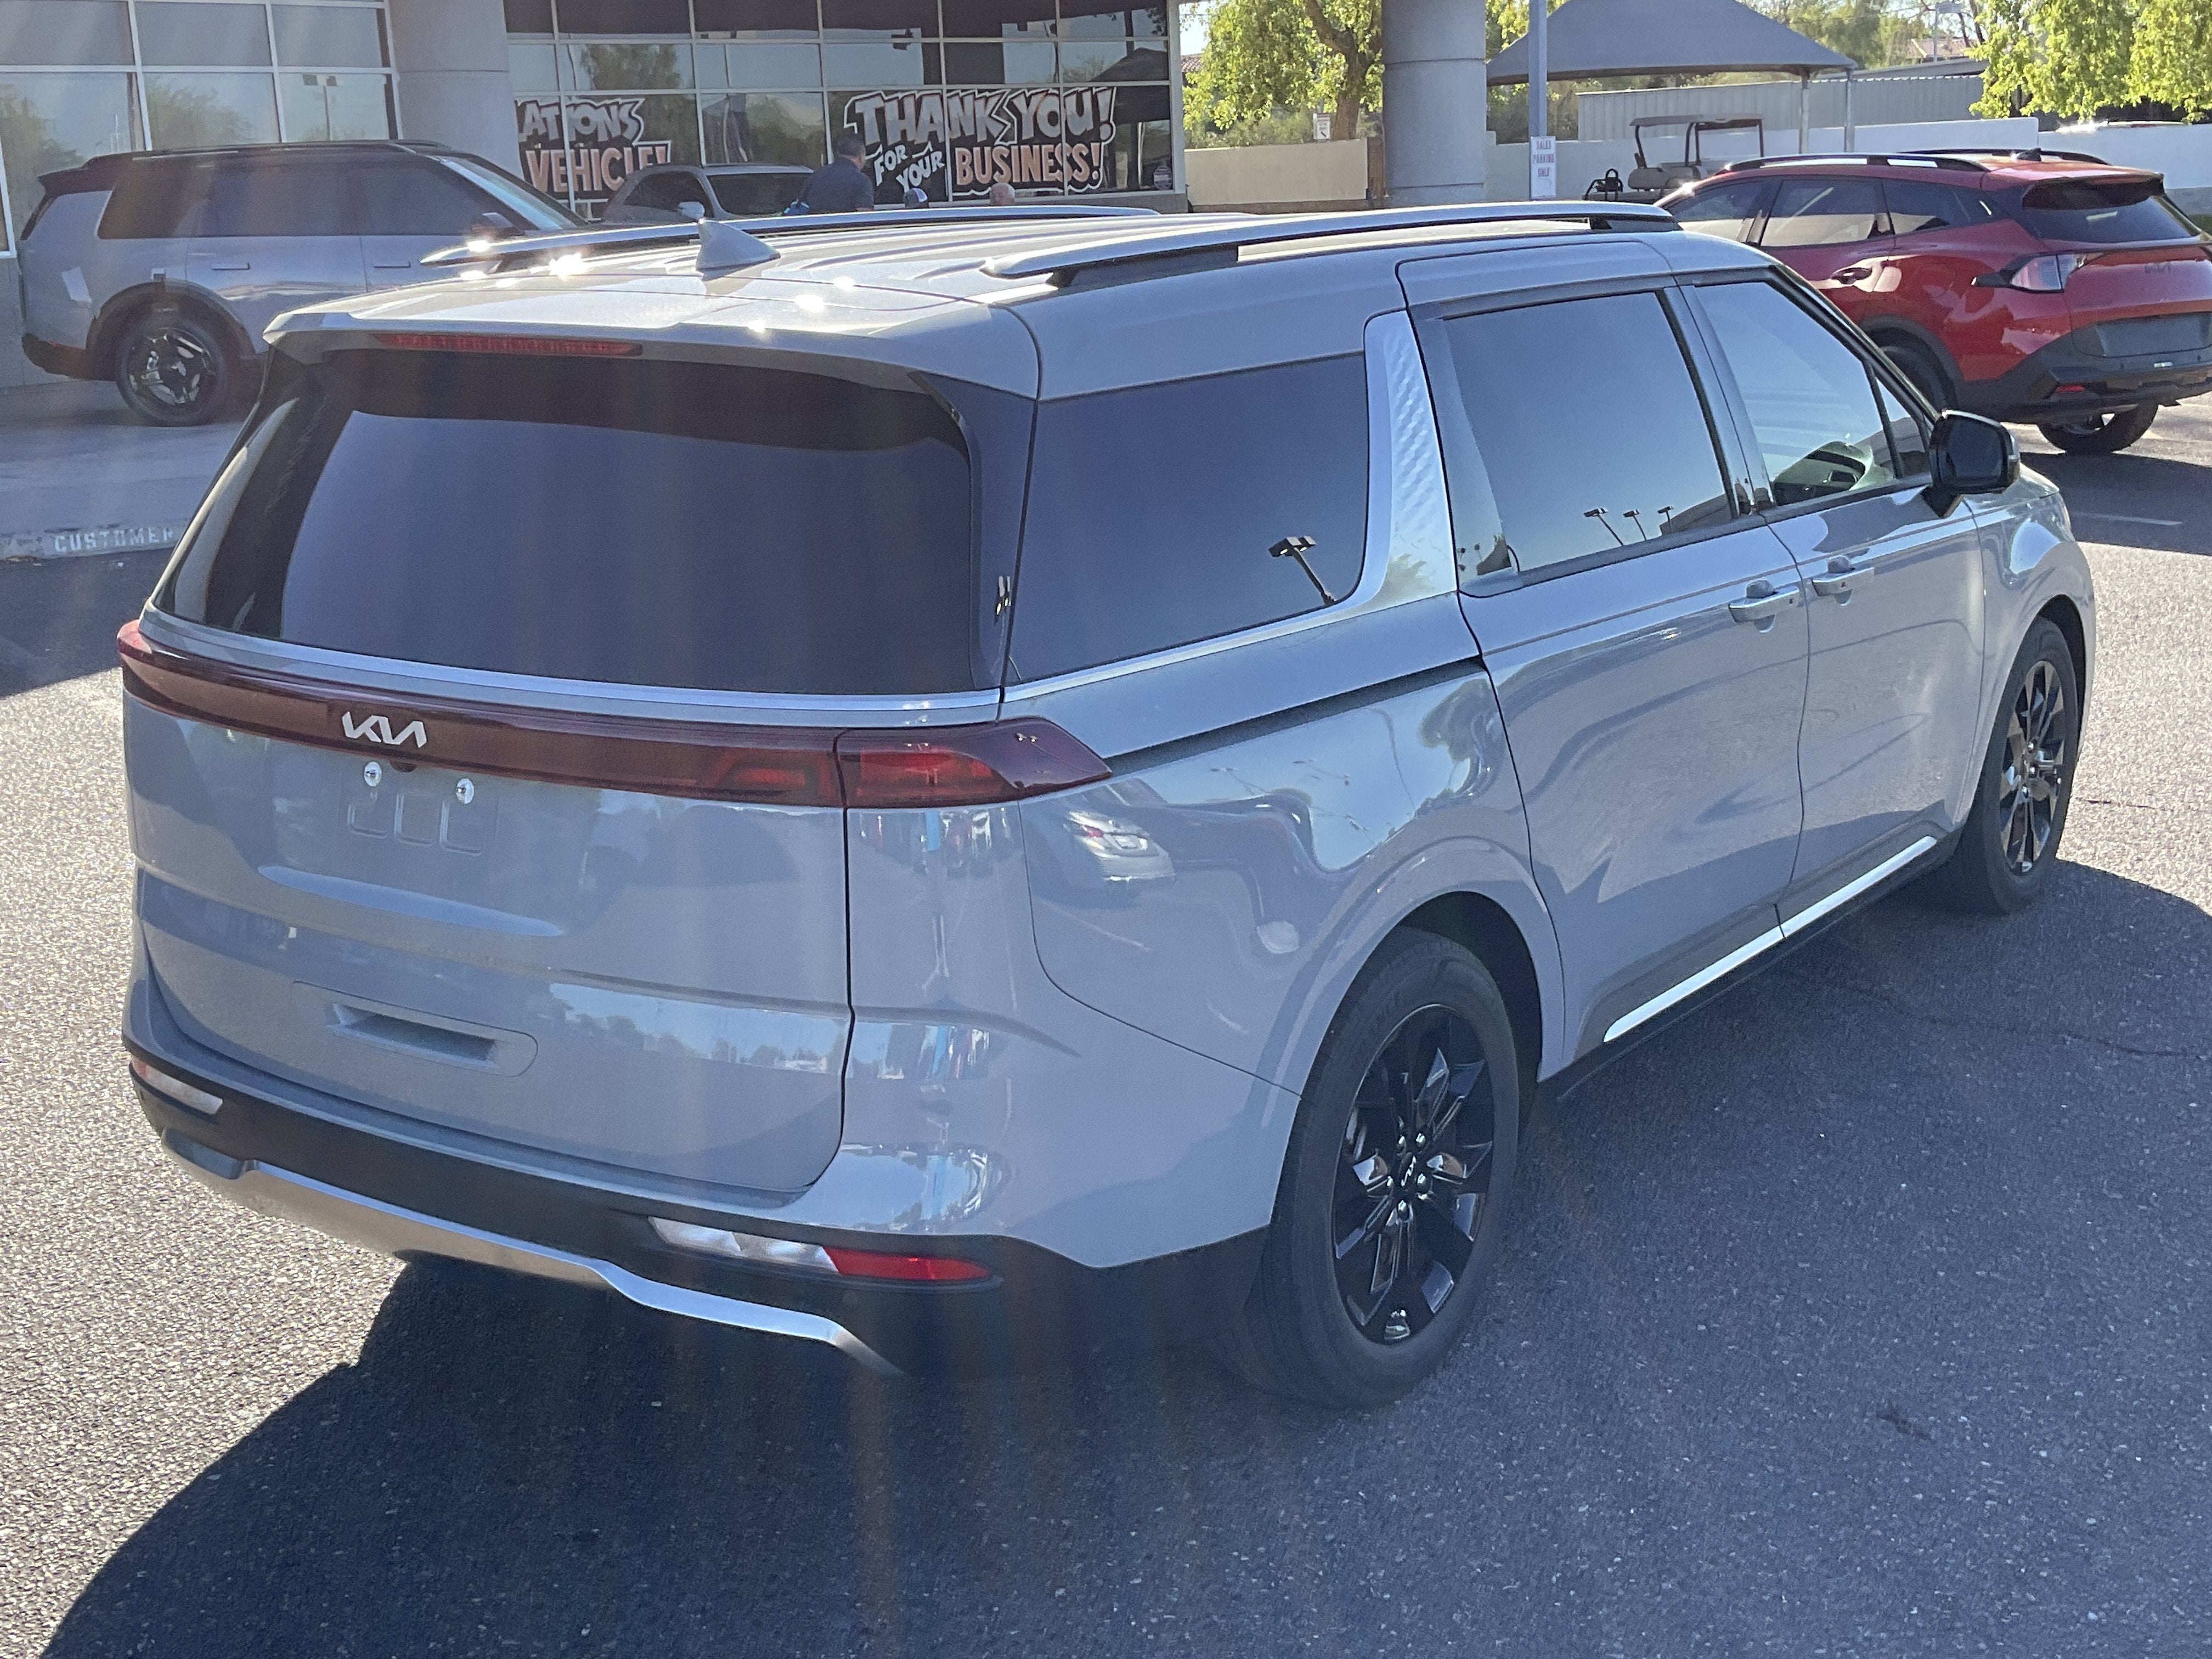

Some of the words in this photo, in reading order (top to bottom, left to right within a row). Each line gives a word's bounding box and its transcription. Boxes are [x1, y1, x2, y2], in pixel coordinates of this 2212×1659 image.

[518, 101, 640, 142] ATIONS
[855, 93, 1005, 146] THANK
[1012, 89, 1113, 141] YOU!
[874, 145, 908, 187] FOR
[896, 150, 945, 193] YOUR
[955, 142, 1101, 185] BUSINESS!
[342, 711, 427, 748] KIA
